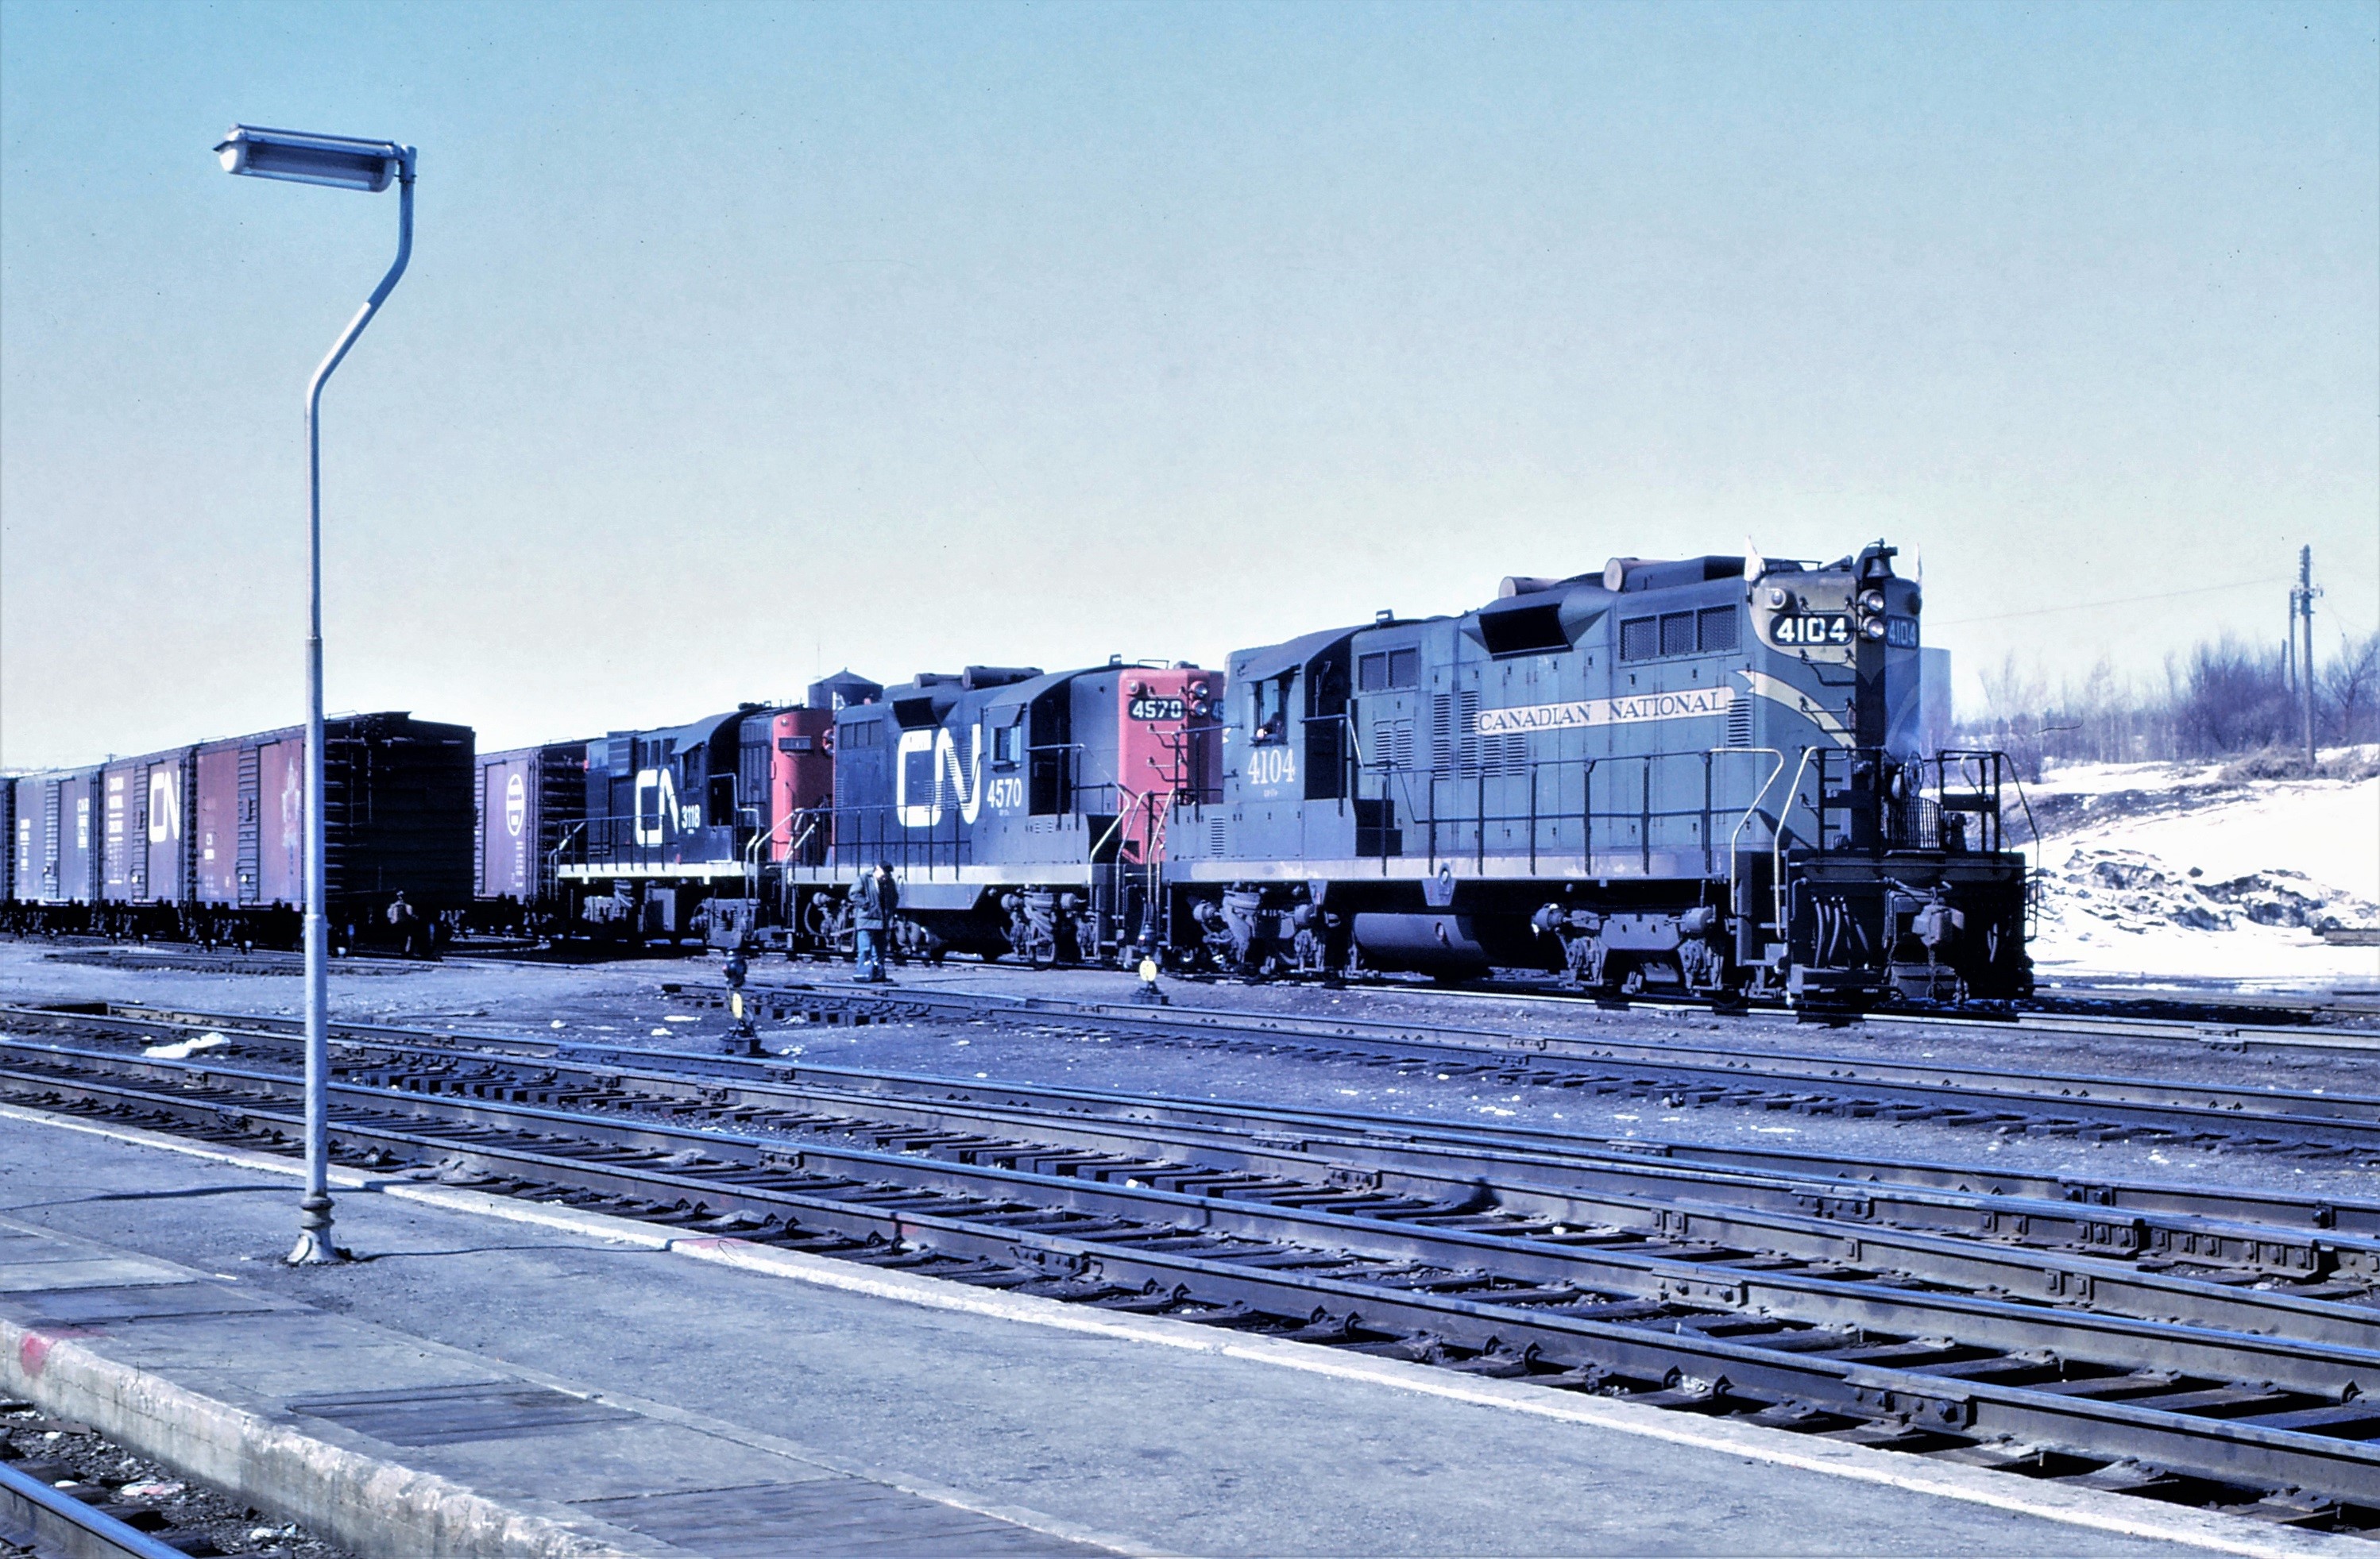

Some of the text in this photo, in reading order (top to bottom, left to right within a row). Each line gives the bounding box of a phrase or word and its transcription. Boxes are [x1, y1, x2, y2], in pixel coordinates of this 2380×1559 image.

[1776, 617, 1847, 642] 4104
[1887, 619, 1917, 646] 4104
[1132, 700, 1182, 718] 4570
[1479, 691, 1728, 731] CANADIAN NATIONAL
[896, 724, 981, 828] CN
[1247, 748, 1296, 785] 4104
[149, 770, 181, 843] CN
[636, 768, 679, 847] CN
[987, 778, 1022, 808] 4570
[682, 804, 701, 829] 3118
